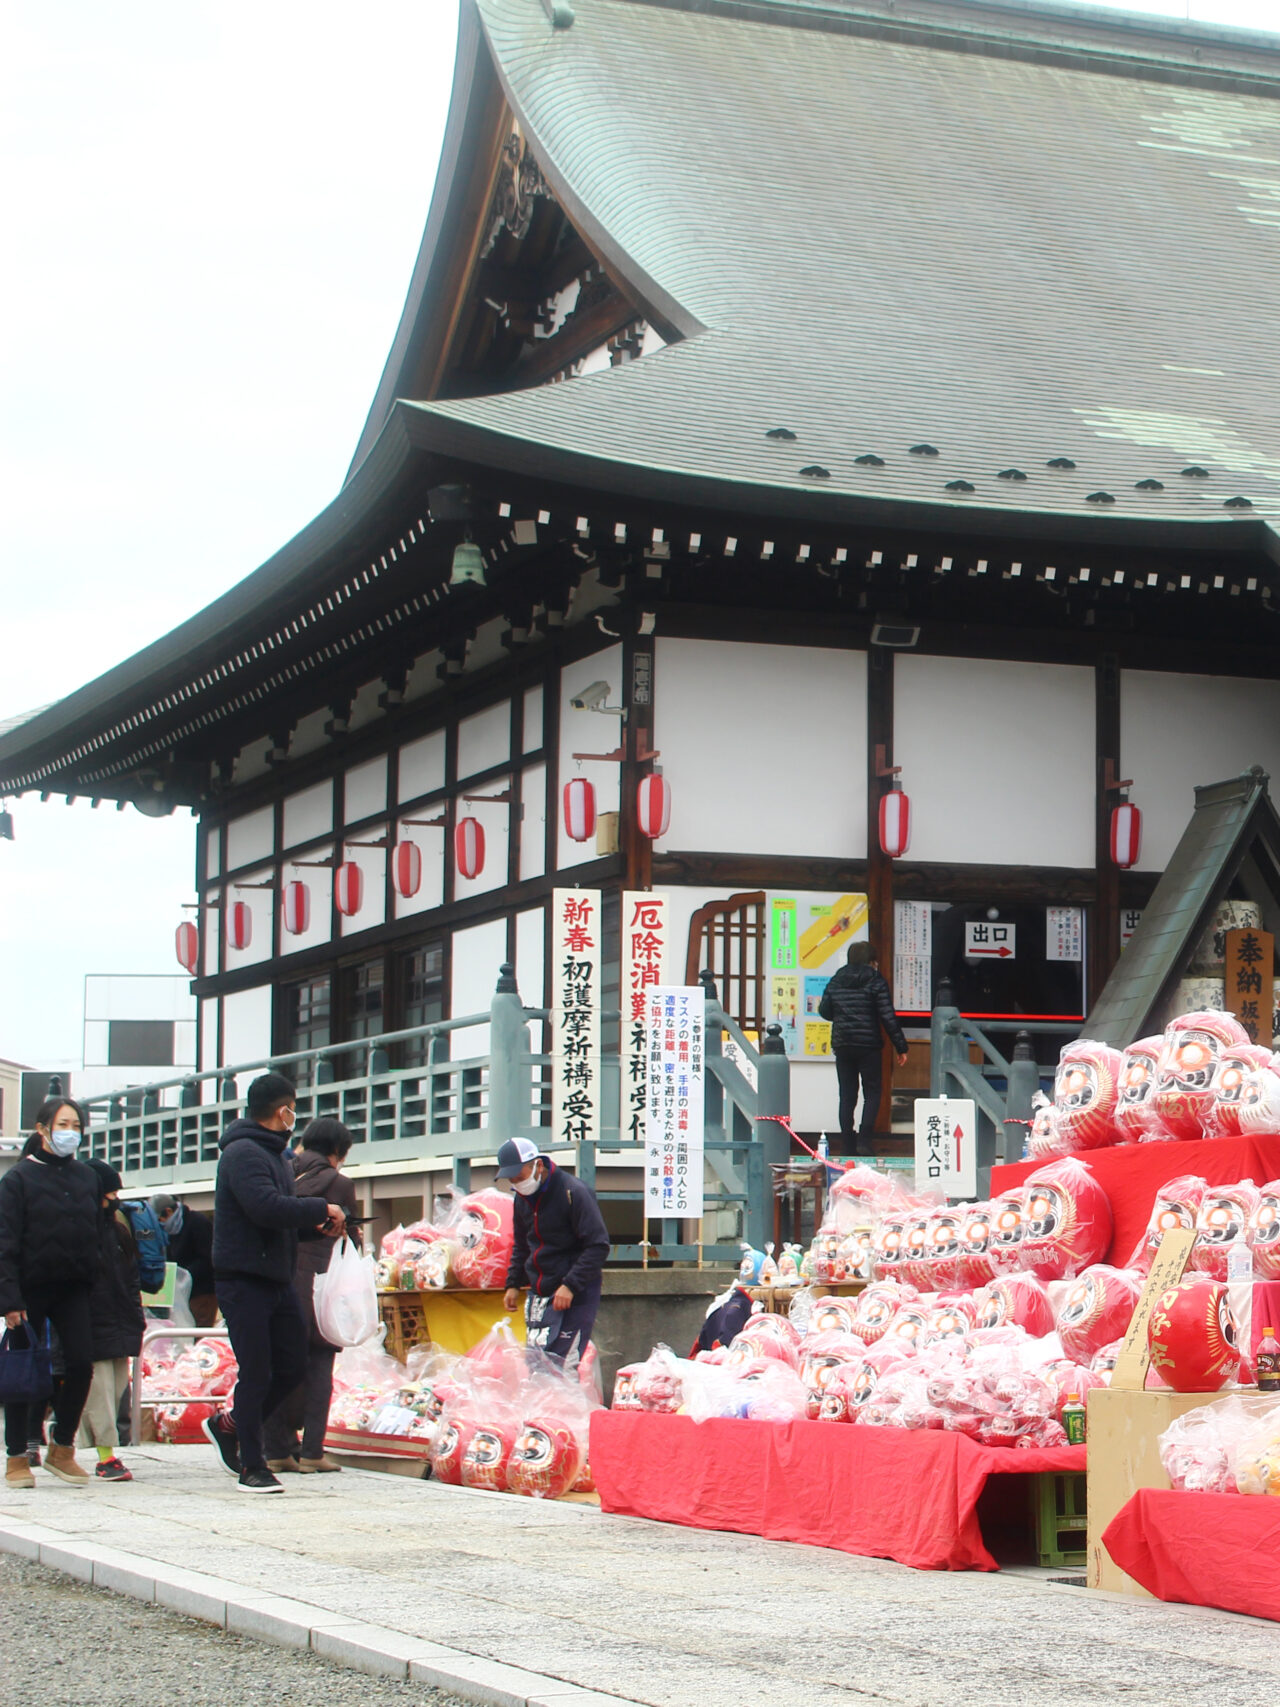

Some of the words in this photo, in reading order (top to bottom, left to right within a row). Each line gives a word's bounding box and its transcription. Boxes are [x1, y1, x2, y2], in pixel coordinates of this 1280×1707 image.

[973, 923, 1008, 943] 出口
[926, 1115, 942, 1178] 受付入口
